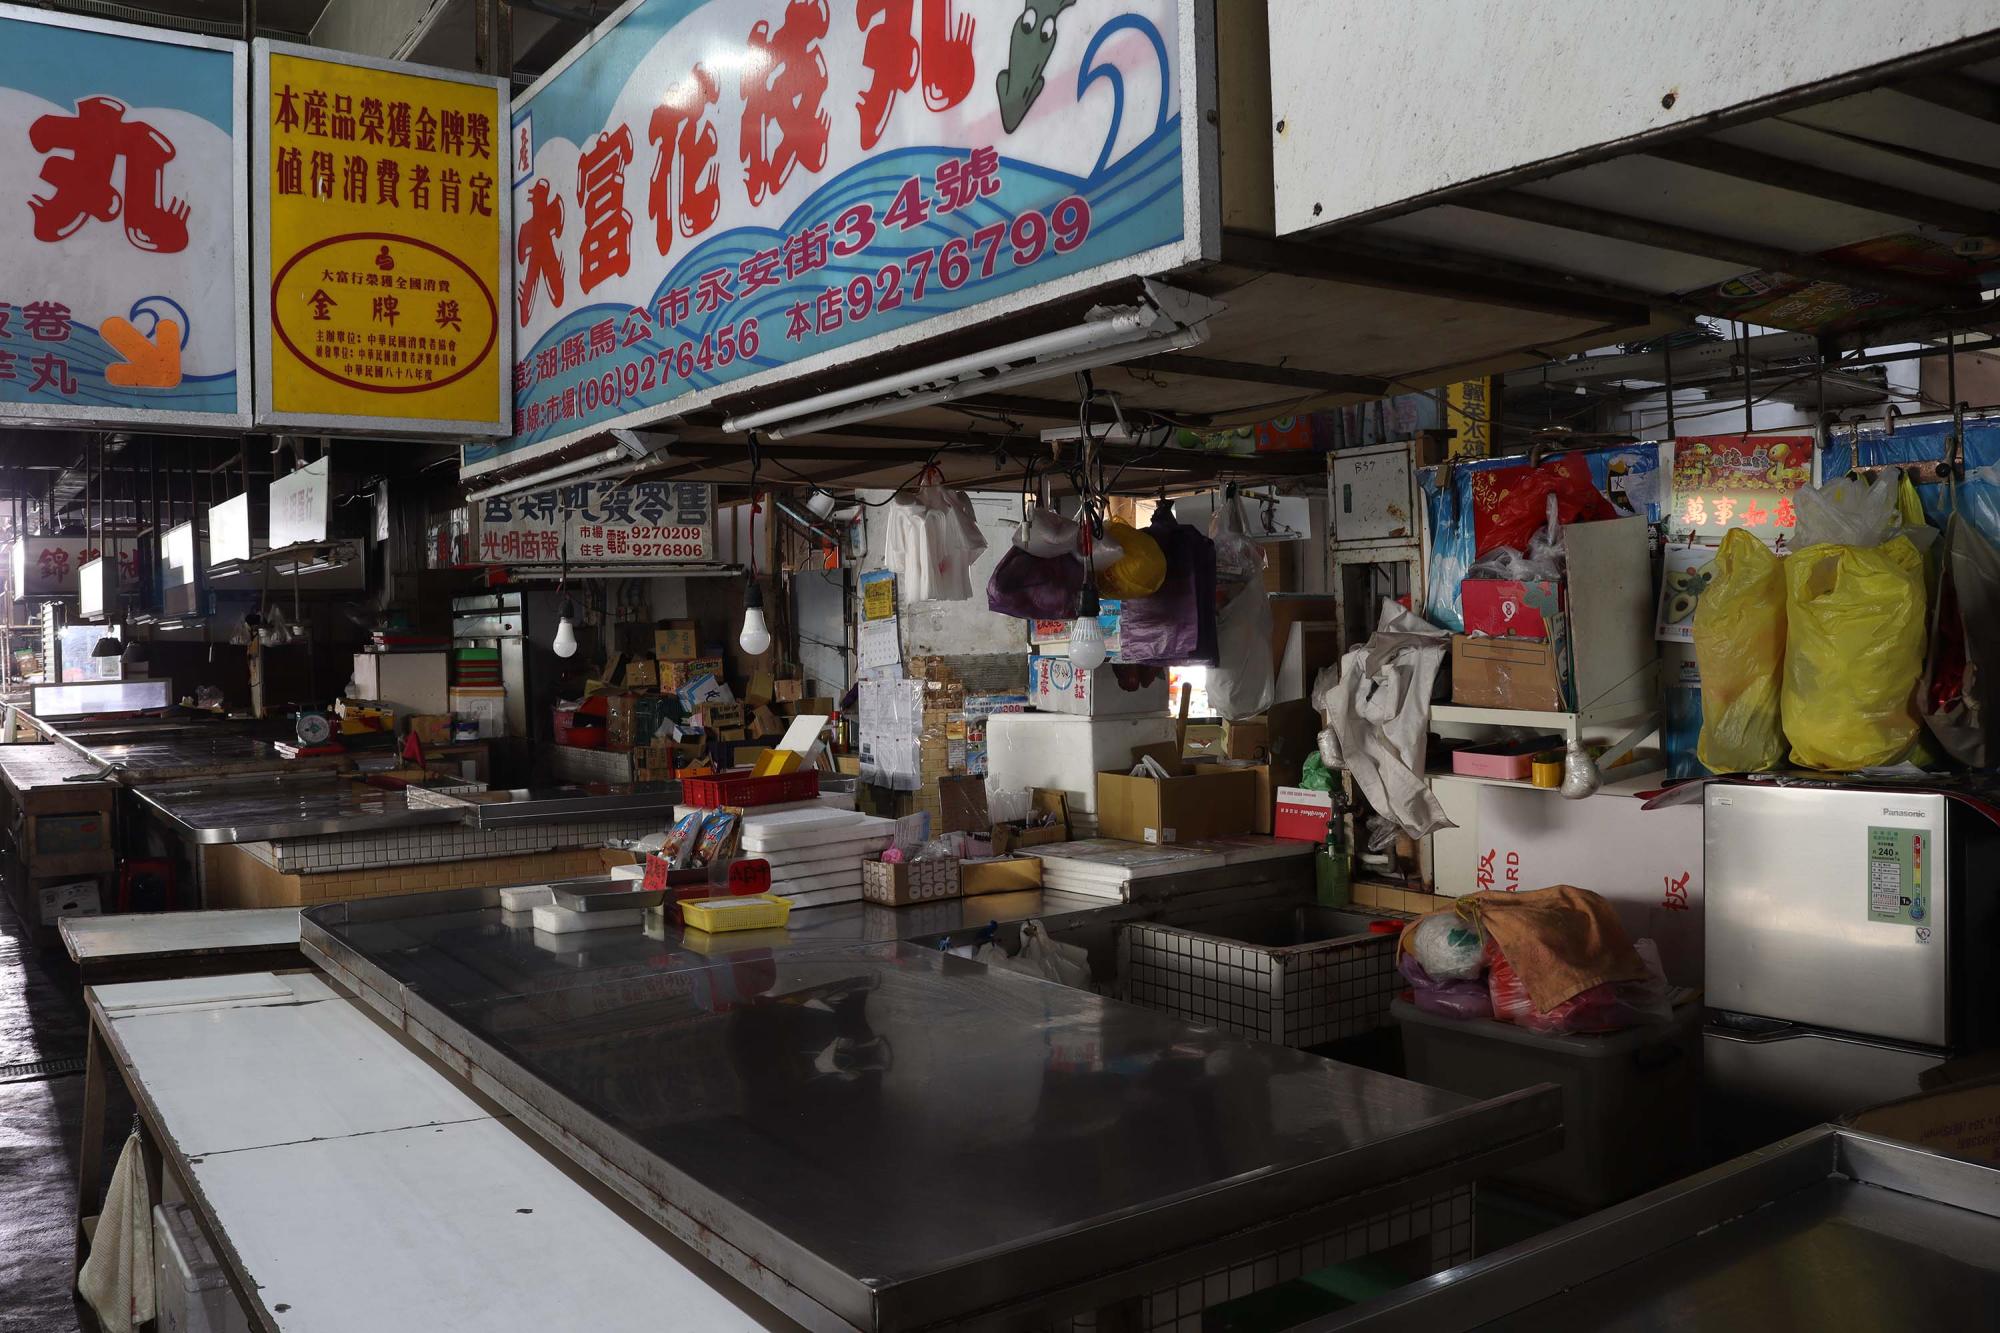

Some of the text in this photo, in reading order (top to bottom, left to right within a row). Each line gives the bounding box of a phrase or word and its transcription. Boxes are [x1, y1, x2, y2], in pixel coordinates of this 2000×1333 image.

[274, 84, 492, 160] 本產品榮獲金牌獎
[27, 94, 191, 254] 丸
[276, 146, 493, 217] 值得消費者肯定
[785, 194, 1092, 345] 本店9276799
[344, 364, 433, 382] 中華民國八十八年度
[1682, 496, 1797, 528] 萬事如意
[481, 530, 560, 561] 光明商號
[631, 526, 701, 540] 9270209
[580, 544, 703, 557] 住宅 9276806
[1883, 808, 1926, 818] Panasonic
